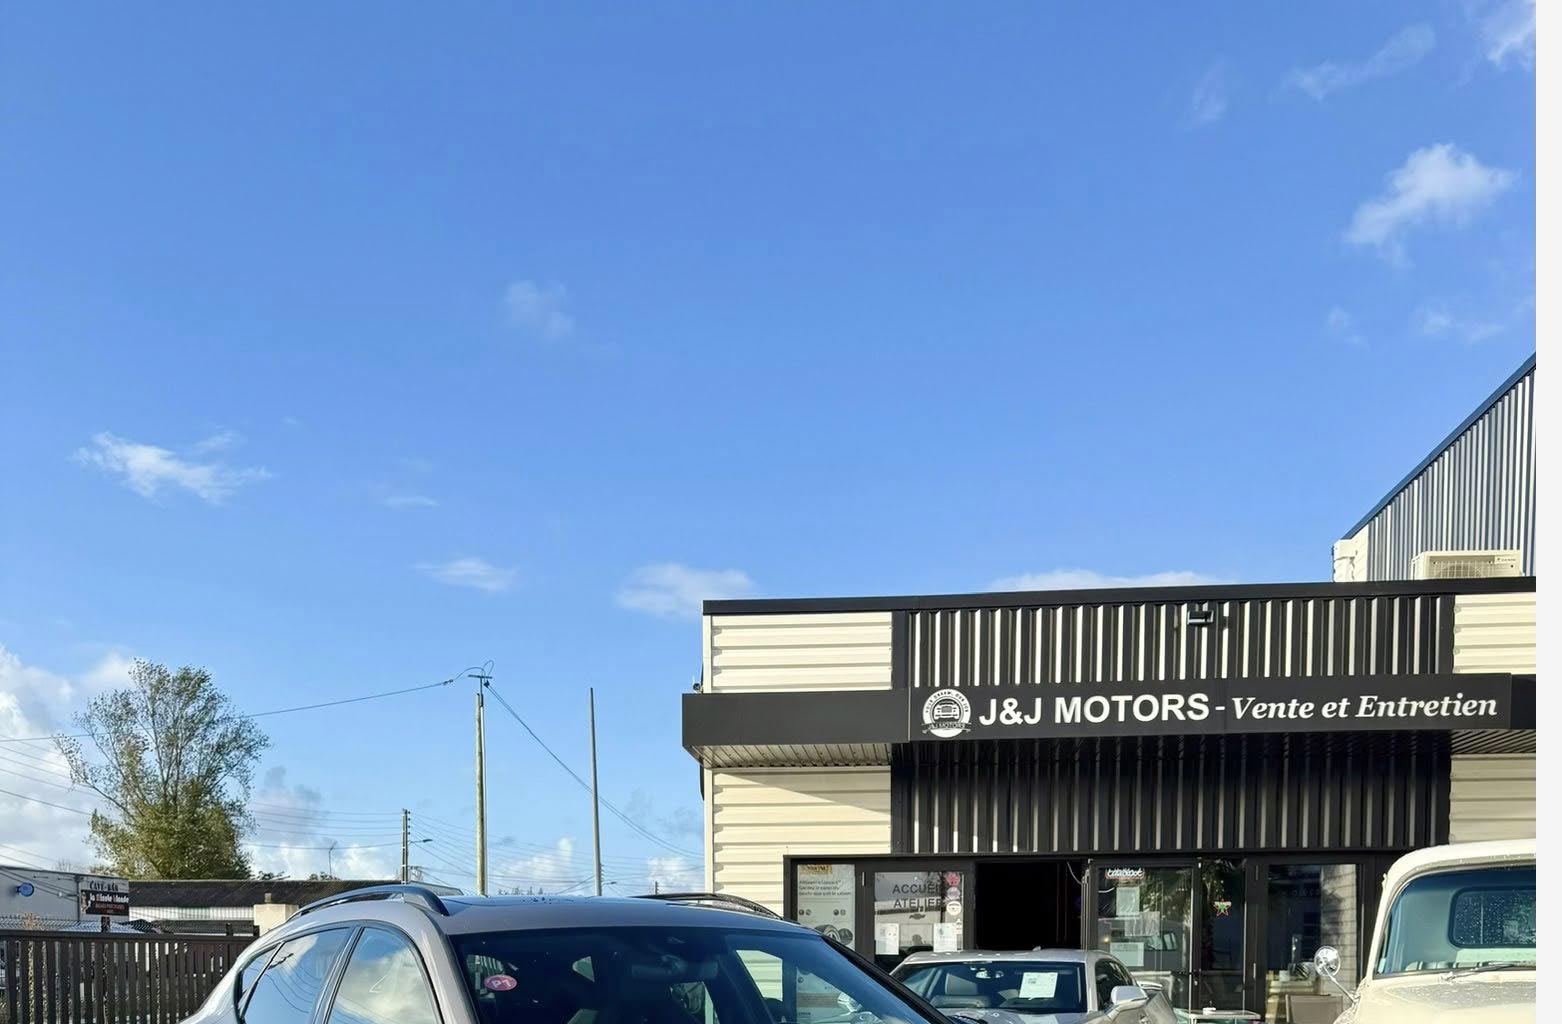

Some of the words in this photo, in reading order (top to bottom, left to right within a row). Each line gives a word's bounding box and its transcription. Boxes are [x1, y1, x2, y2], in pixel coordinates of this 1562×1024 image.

[978, 697, 1042, 726] J&J
[1054, 692, 1210, 724] MOTORS
[1231, 696, 1315, 720] Vente
[1321, 697, 1351, 718] et
[1355, 692, 1498, 718] Entretien
[892, 884, 943, 894] ACCUEI
